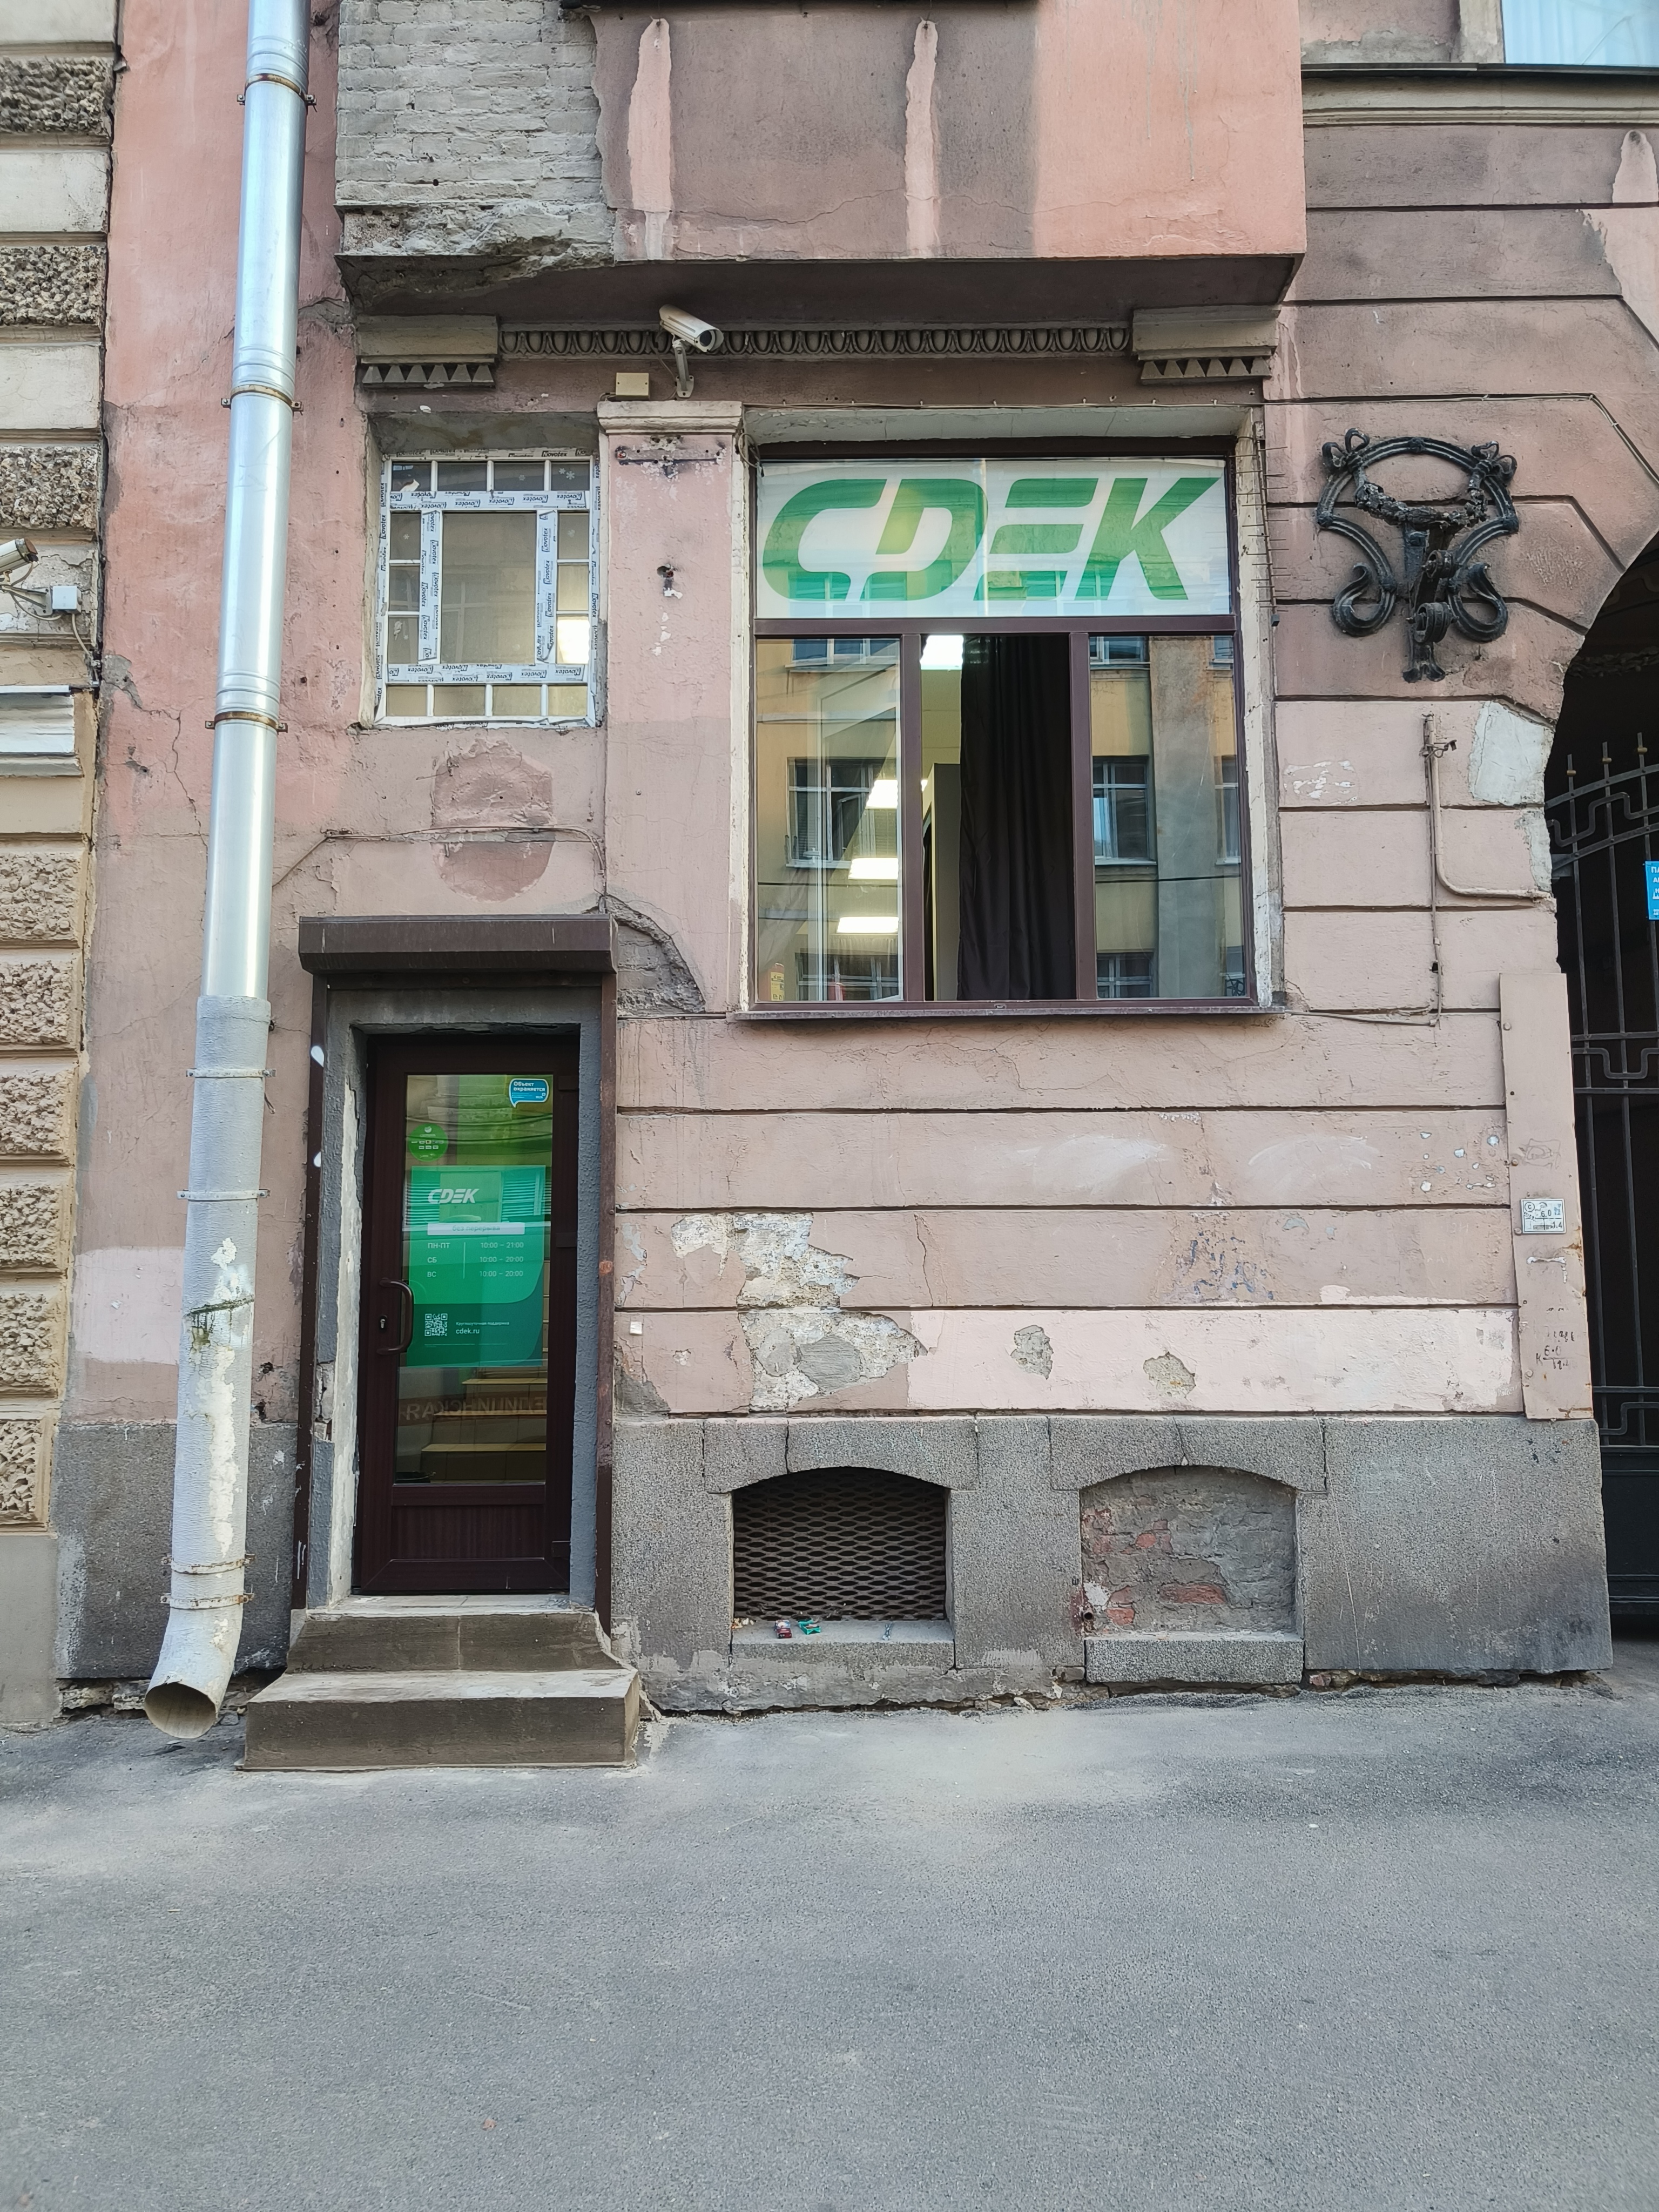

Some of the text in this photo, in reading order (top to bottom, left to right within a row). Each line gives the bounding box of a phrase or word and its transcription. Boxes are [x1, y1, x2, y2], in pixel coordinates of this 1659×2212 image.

[489, 497, 515, 505] Novotex
[523, 495, 548, 503] Novotex
[556, 492, 582, 500] Novotex
[455, 500, 481, 508] Novotex
[542, 528, 550, 552] Novotex
[762, 478, 1220, 602] CDEK
[430, 540, 439, 564] Novotex
[543, 561, 552, 584] Novotex
[545, 593, 554, 617] Novotex
[422, 615, 430, 640] Novotex
[407, 665, 433, 673] Novotex
[555, 667, 581, 676] Novotex
[428, 1189, 480, 1204] CDEK
